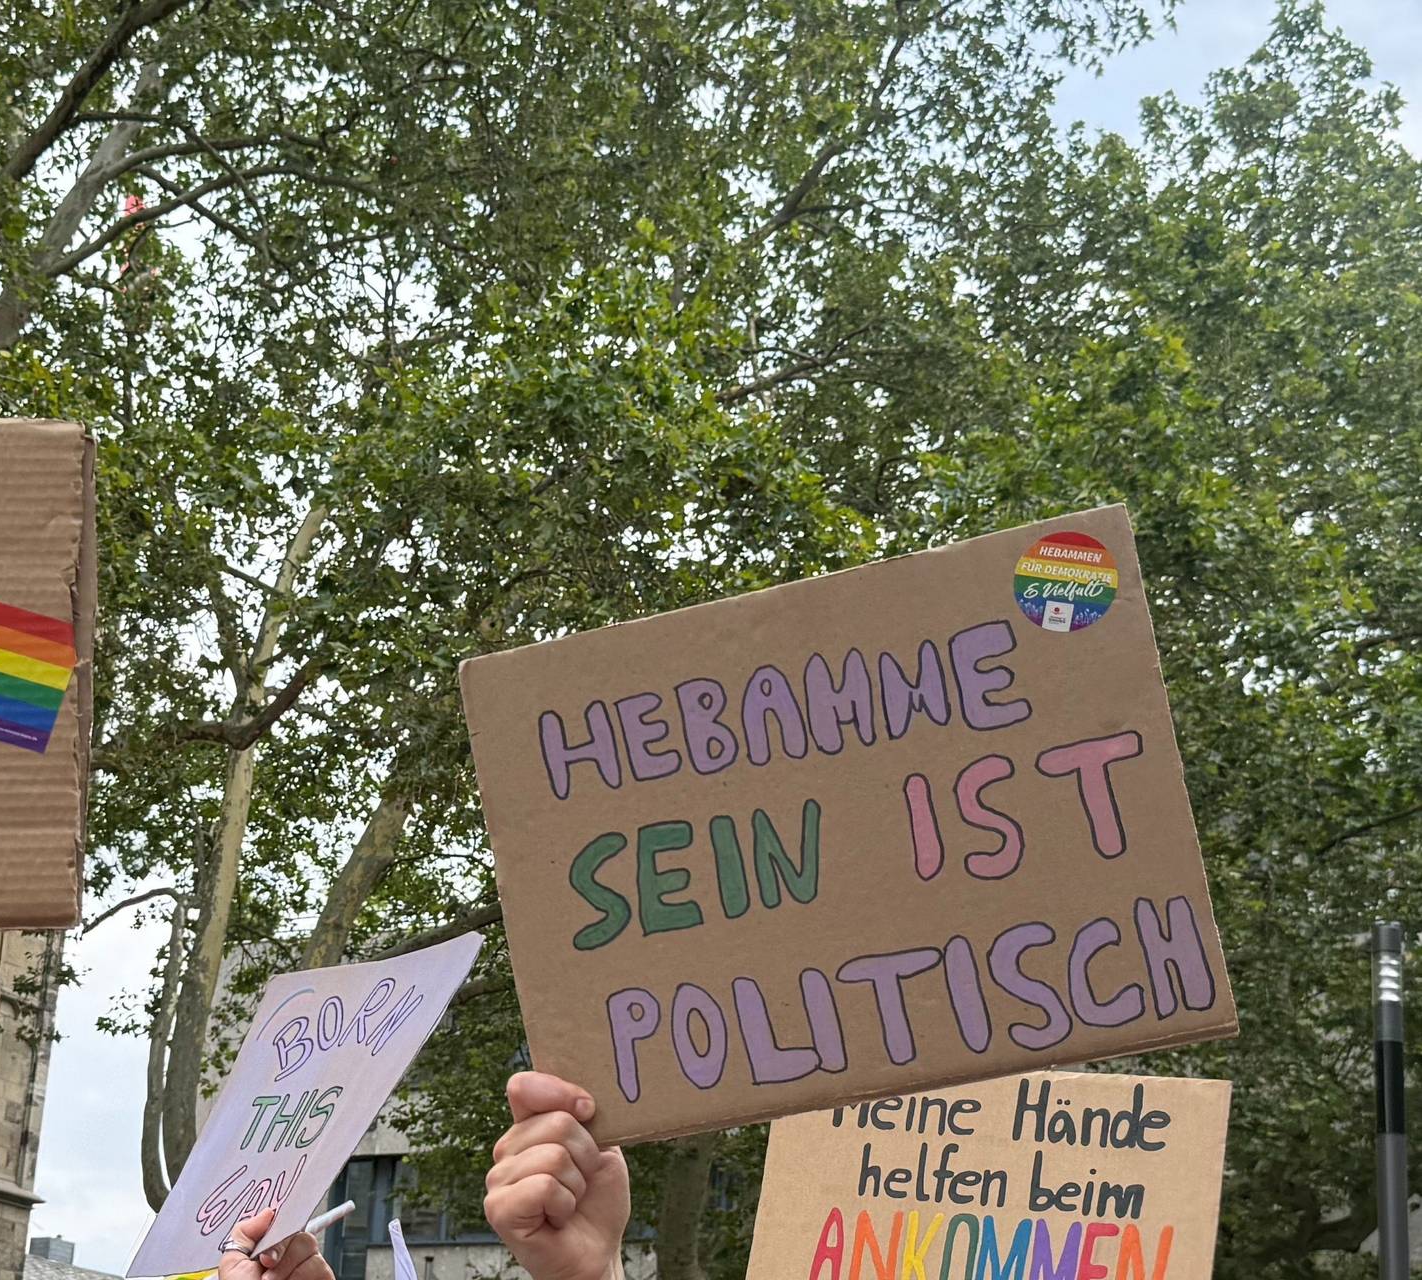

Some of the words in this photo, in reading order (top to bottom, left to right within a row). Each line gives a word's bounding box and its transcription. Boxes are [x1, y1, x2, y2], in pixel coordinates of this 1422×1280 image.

[1023, 582, 1040, 599] &
[1042, 579, 1105, 602] Vielfalt
[1039, 546, 1103, 563] HEBAMMEN
[1044, 564, 1113, 584] DEMOKRATIE
[538, 619, 1034, 800] HEBAMME
[569, 799, 822, 951] SEIN
[902, 730, 1143, 881] IST
[273, 977, 424, 1082] BORN
[606, 895, 1215, 1103] POLITISCH
[239, 1085, 344, 1153] THIS
[1011, 1078, 1172, 1151] Hände
[857, 1142, 1009, 1209] helfen
[1028, 1150, 1146, 1220] beim
[808, 1207, 1175, 1280] ANKOMMEN
